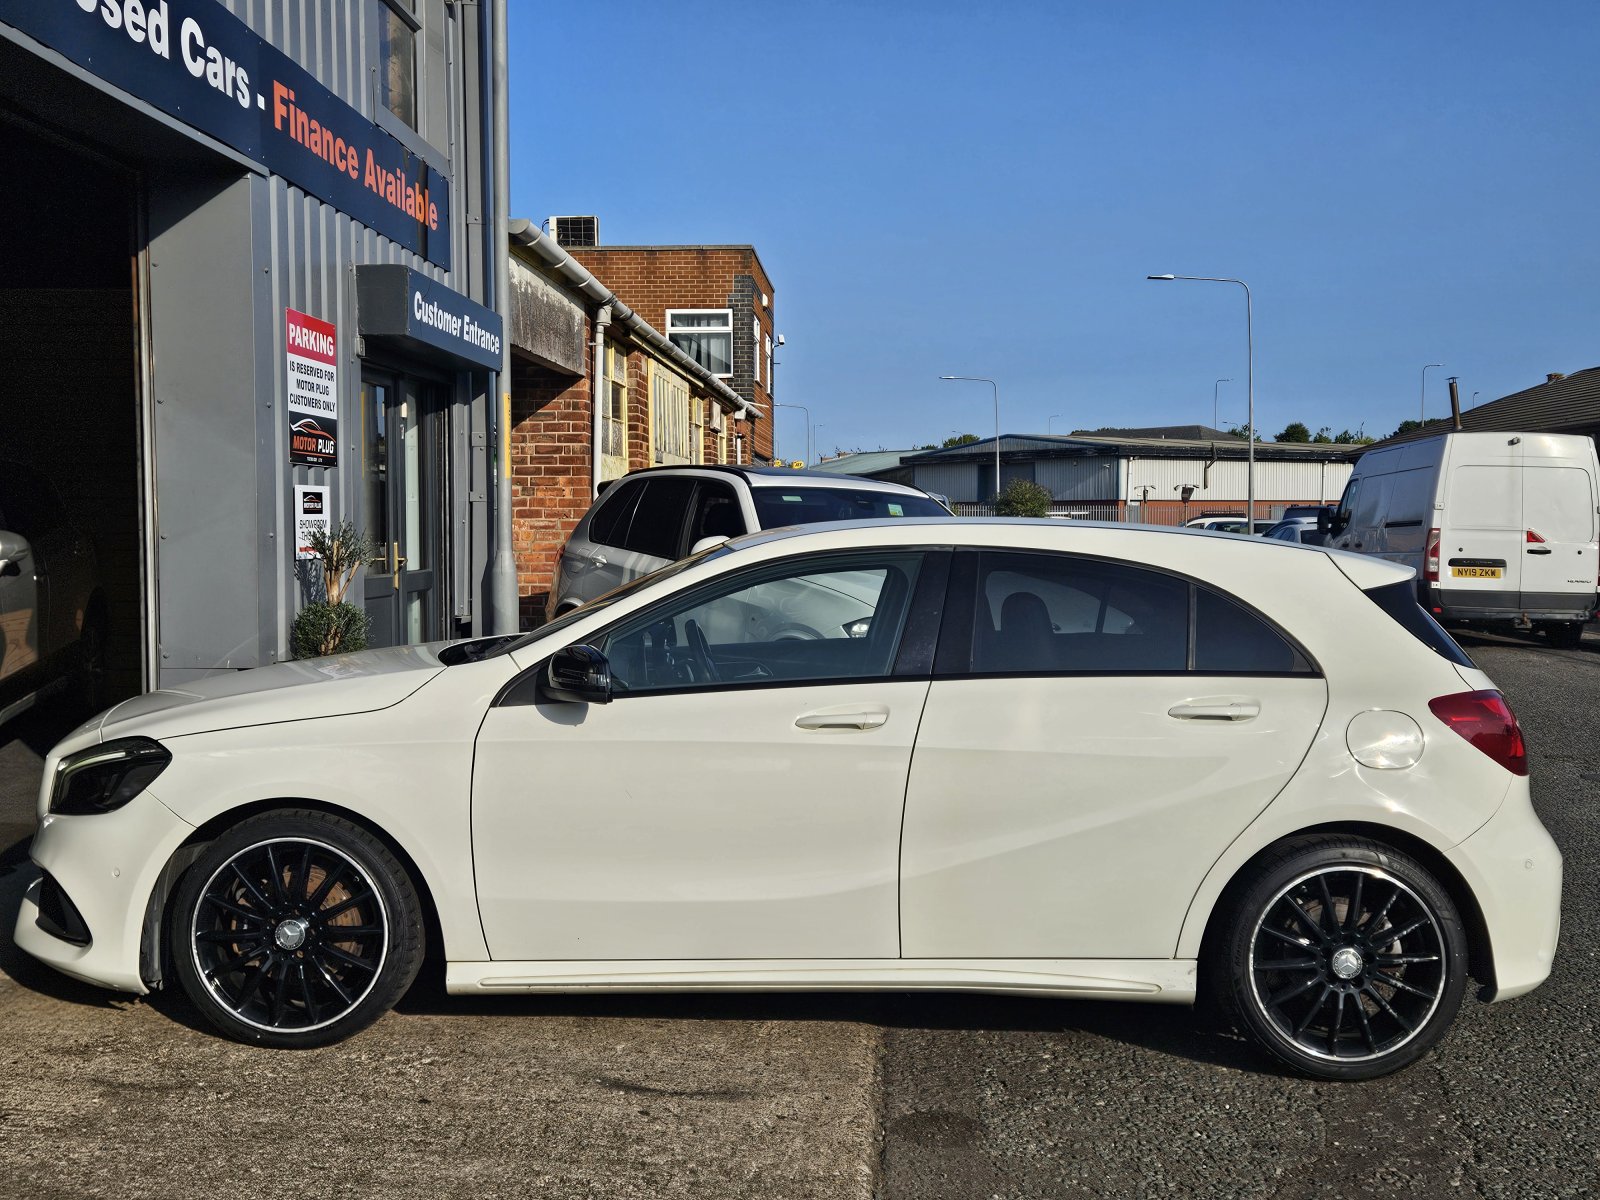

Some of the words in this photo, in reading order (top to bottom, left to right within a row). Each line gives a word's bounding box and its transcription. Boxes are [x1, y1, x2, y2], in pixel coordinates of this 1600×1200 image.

[76, 0, 170, 59] sed
[181, 17, 250, 108] Cars
[273, 80, 359, 180] Finance
[364, 148, 438, 231] Available
[414, 291, 462, 338] Customer
[463, 314, 500, 354] Entrance
[289, 322, 334, 357] PARKING
[289, 360, 296, 372] IS
[296, 362, 323, 379] RESERVED
[324, 369, 335, 382] FOR
[296, 378, 315, 393] MOTOR
[315, 383, 329, 396] PLUG
[289, 393, 322, 410] CUSTOMERS
[323, 400, 335, 413] ONLY
[293, 435, 317, 451] MOTOR
[318, 438, 334, 454] PLUG
[1457, 568, 1477, 577] NY19
[1479, 568, 1496, 577] ZKW
